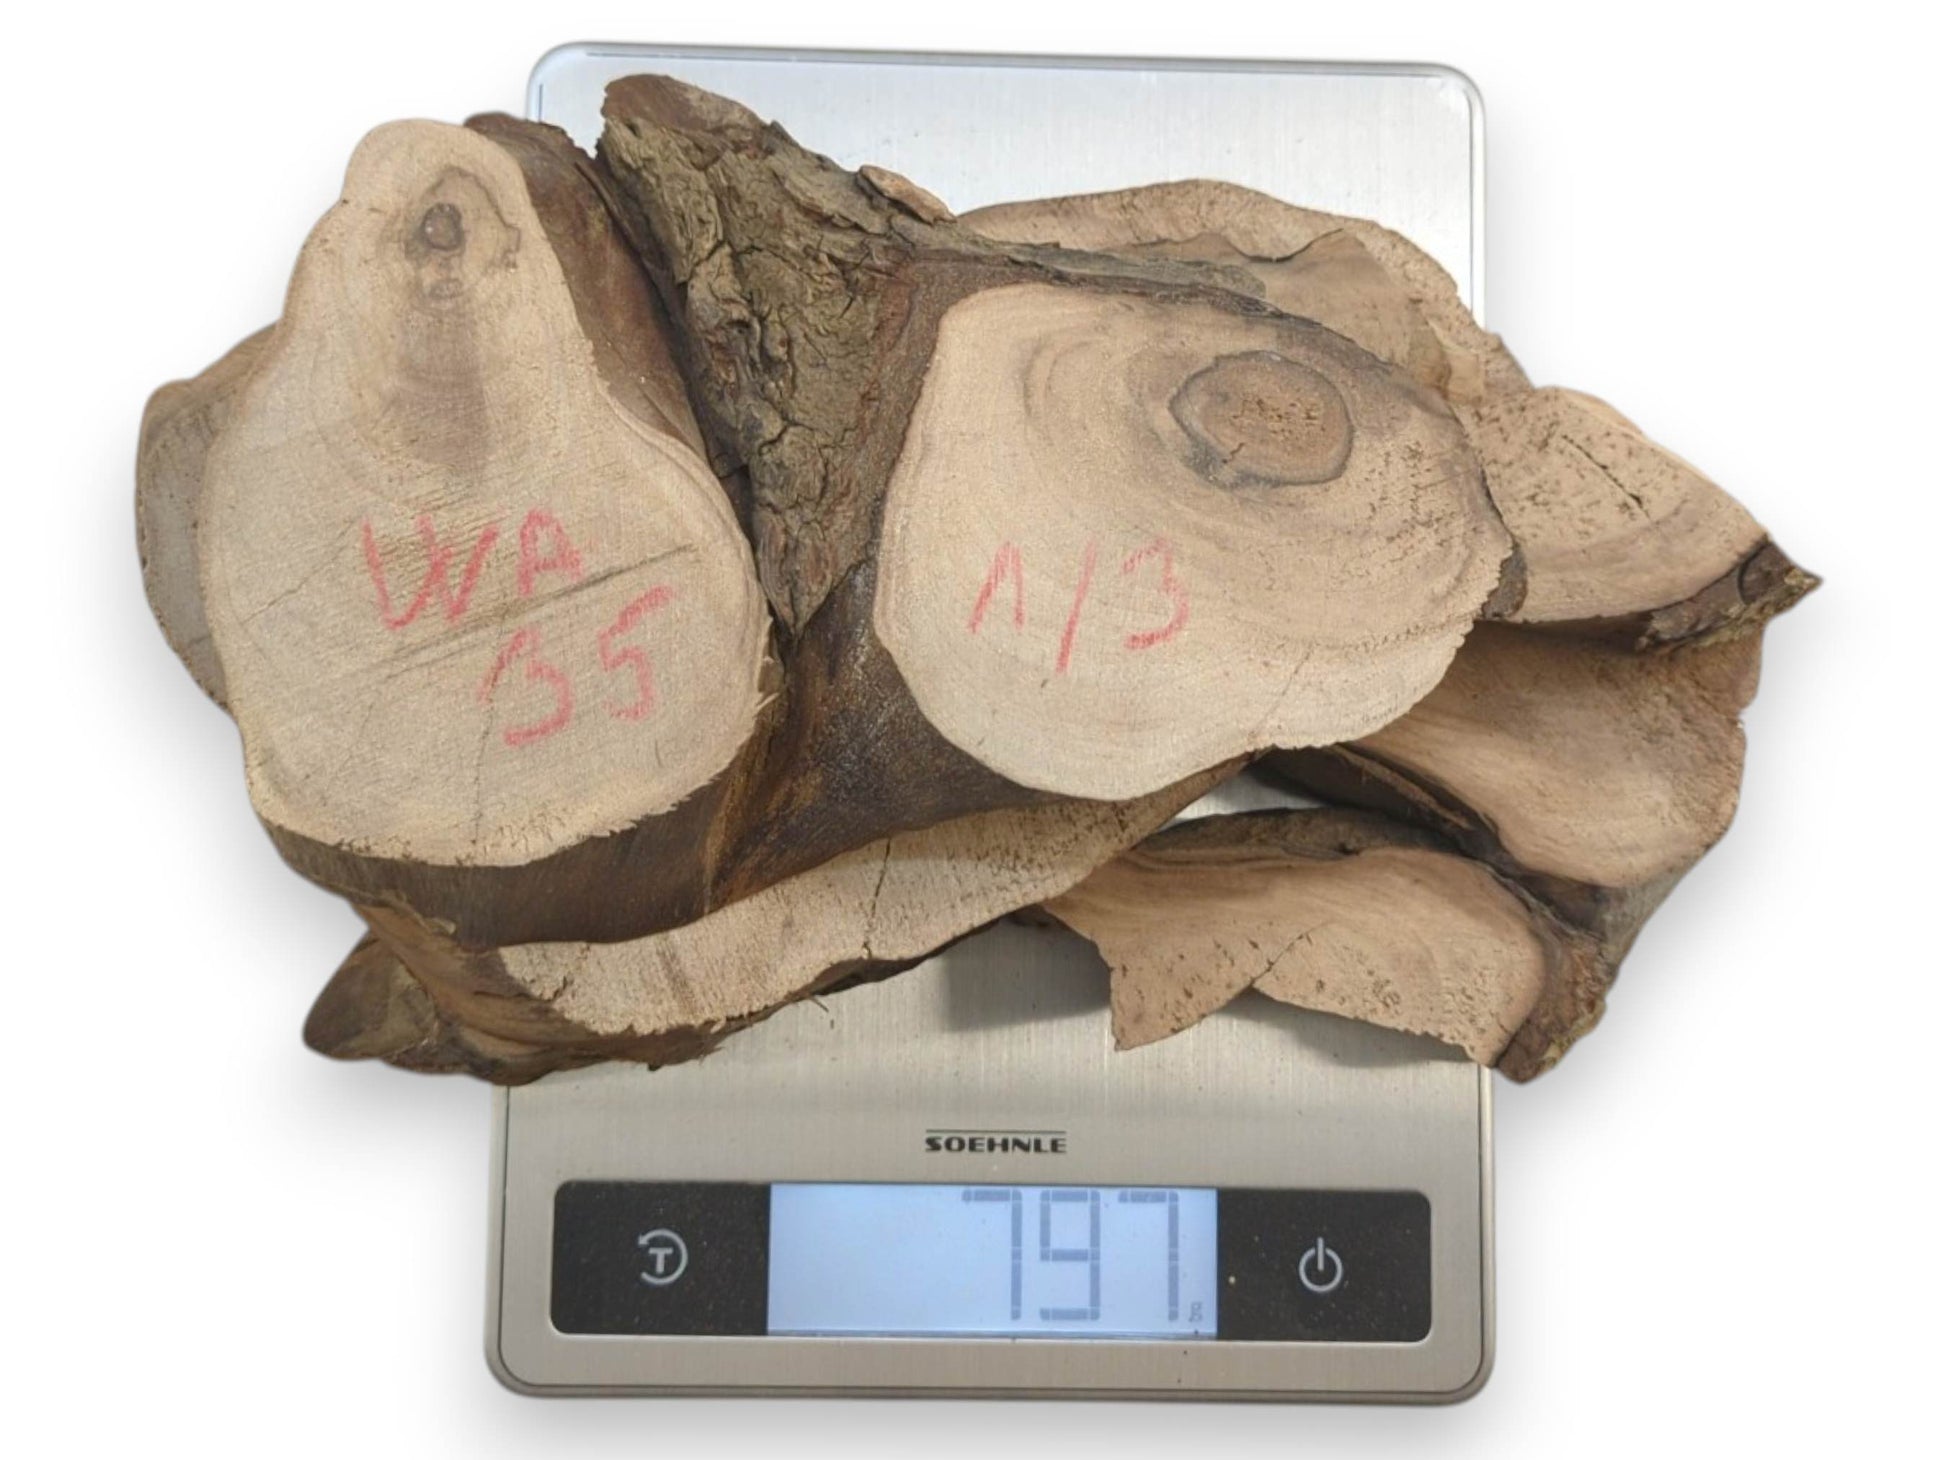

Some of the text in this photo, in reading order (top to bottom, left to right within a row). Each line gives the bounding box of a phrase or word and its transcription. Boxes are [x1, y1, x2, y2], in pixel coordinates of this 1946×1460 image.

[360, 506, 583, 630] WA
[966, 532, 1190, 675] 1/3
[476, 584, 676, 747] 35
[924, 1136, 1068, 1154] SOEHNLE
[961, 1189, 1179, 1321] 797
